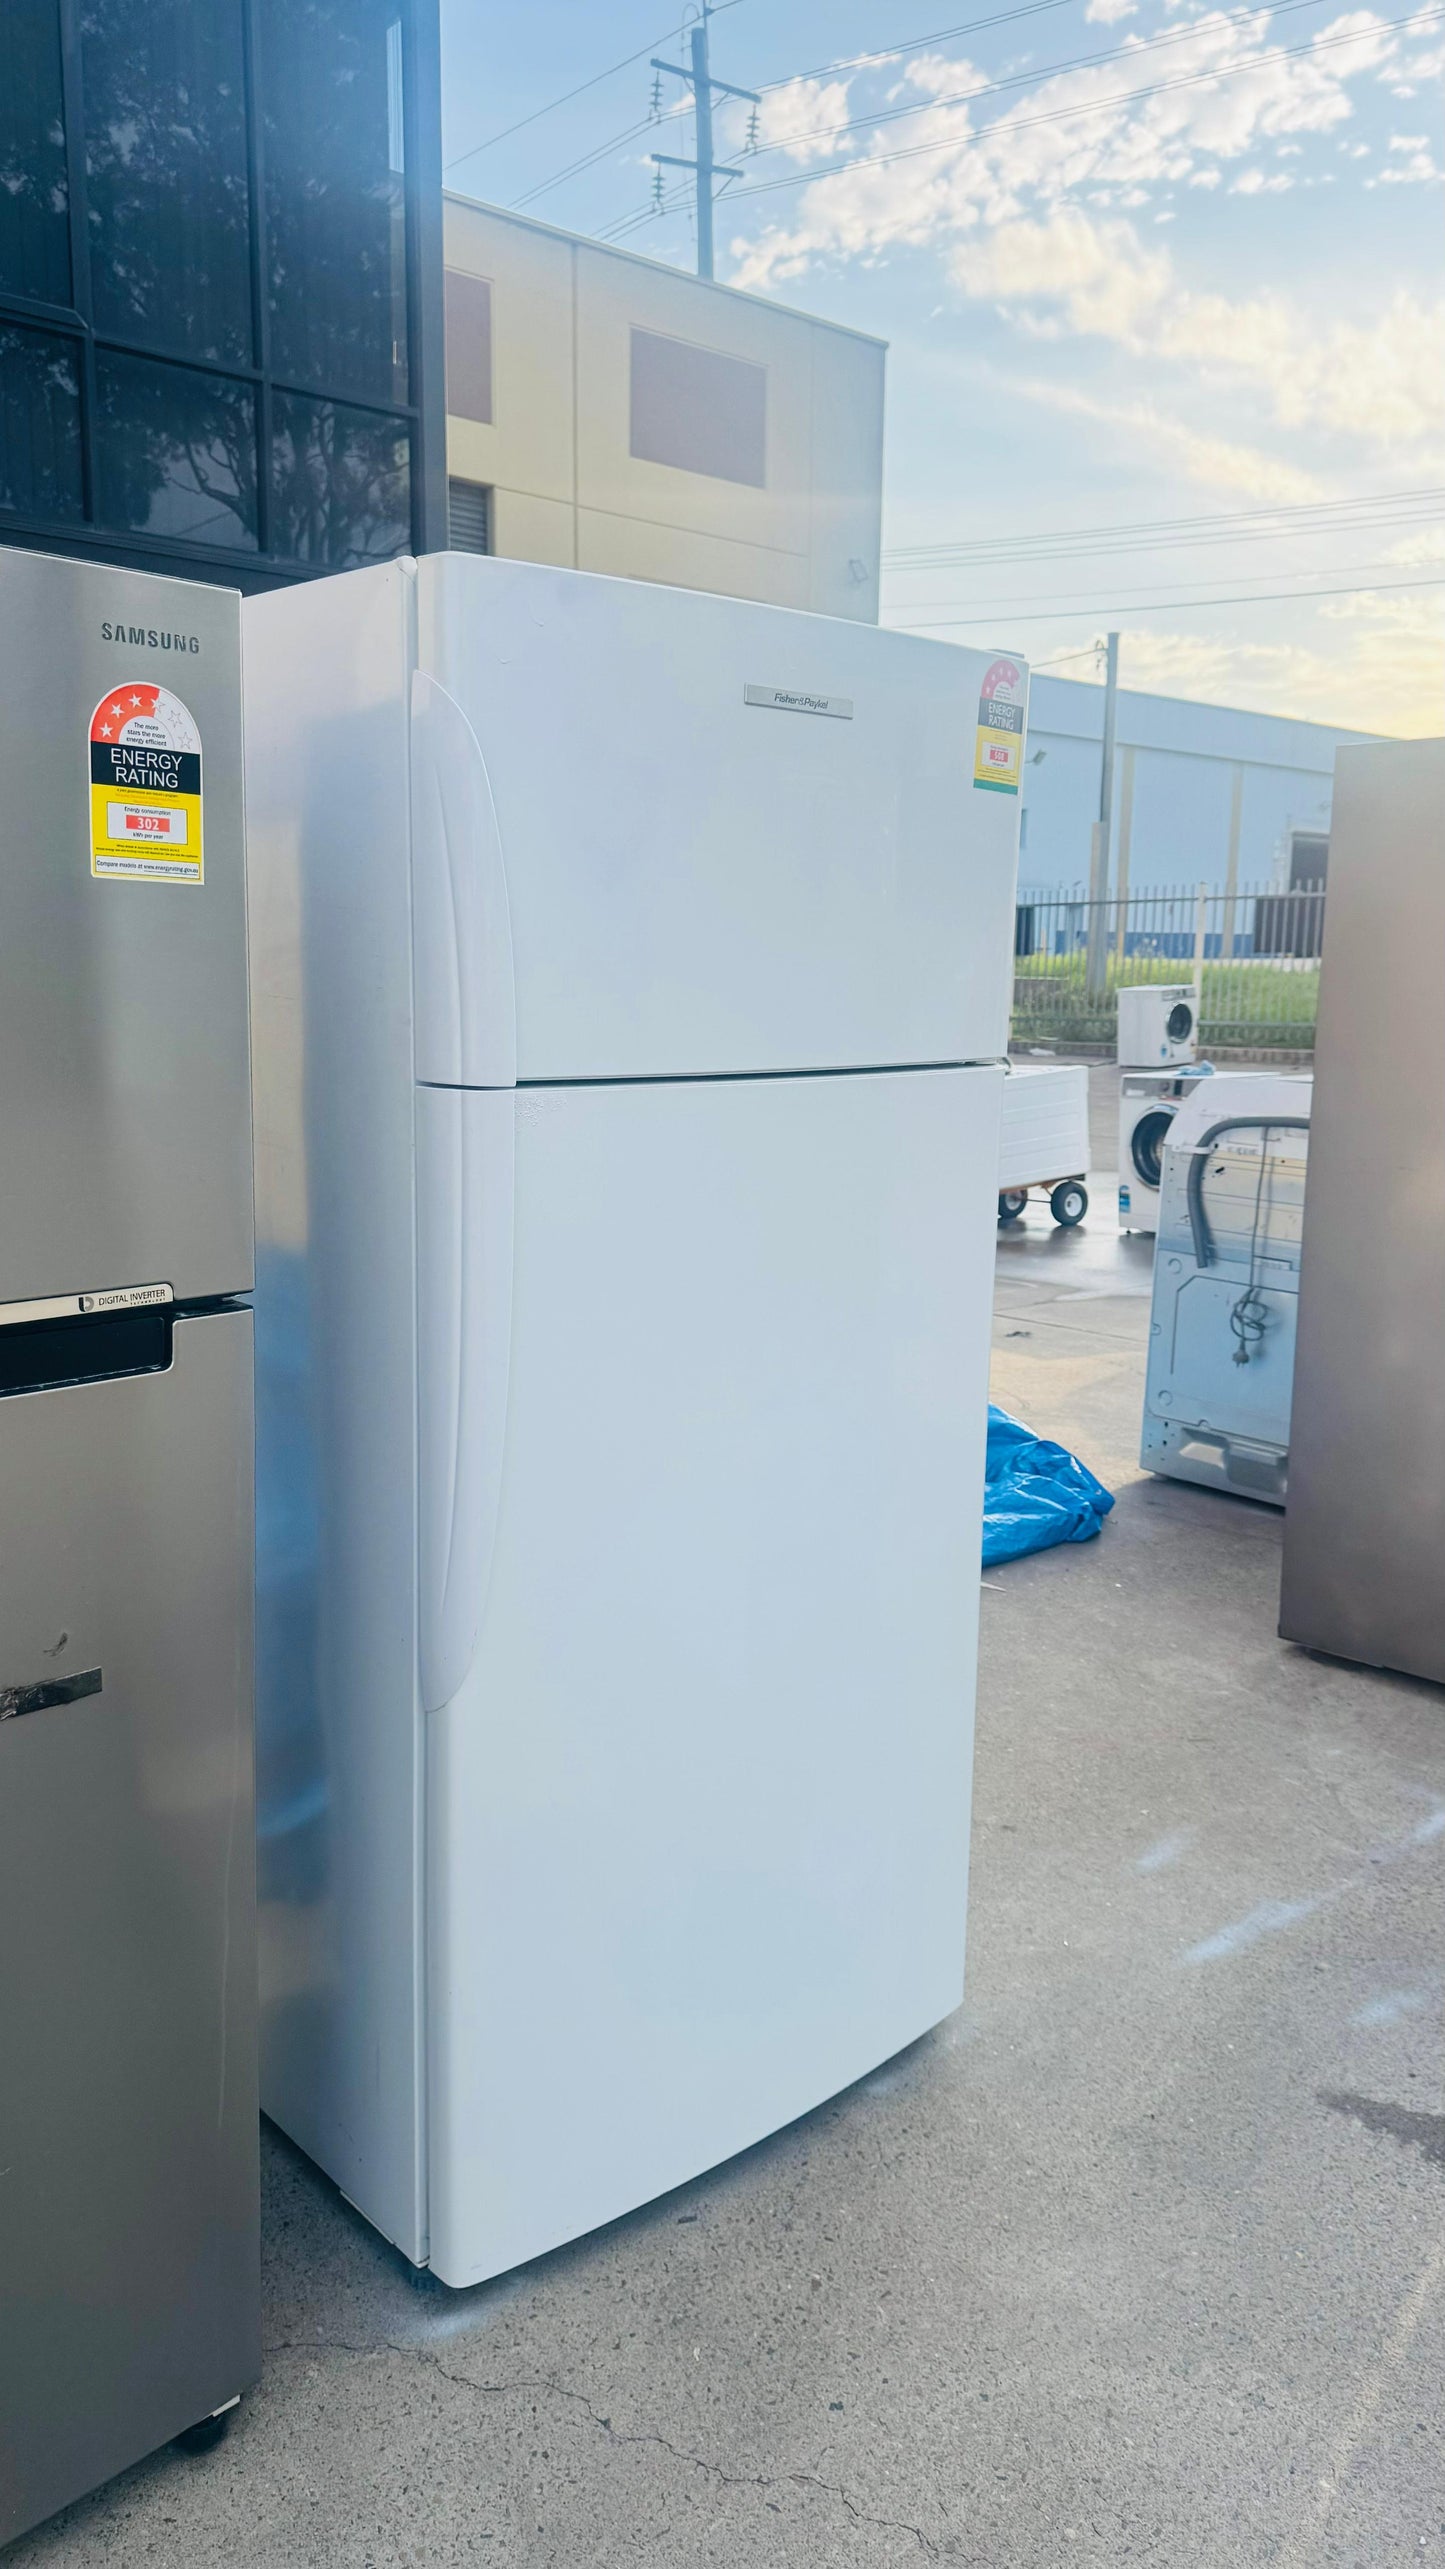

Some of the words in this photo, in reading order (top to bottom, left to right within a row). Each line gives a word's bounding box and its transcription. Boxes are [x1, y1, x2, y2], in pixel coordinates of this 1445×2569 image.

[101, 622, 200, 654] SAMSUNG
[988, 702, 1016, 718] ENERGY
[988, 715, 1014, 730] RATING
[111, 748, 183, 771] ENERGY
[116, 766, 179, 788] RATING
[124, 806, 141, 814] Energy
[141, 808, 172, 816] consumption
[137, 817, 160, 831] 302
[96, 860, 118, 868] Compare
[98, 1294, 128, 1306] DIGITAL
[130, 1291, 166, 1301] INVERTER
